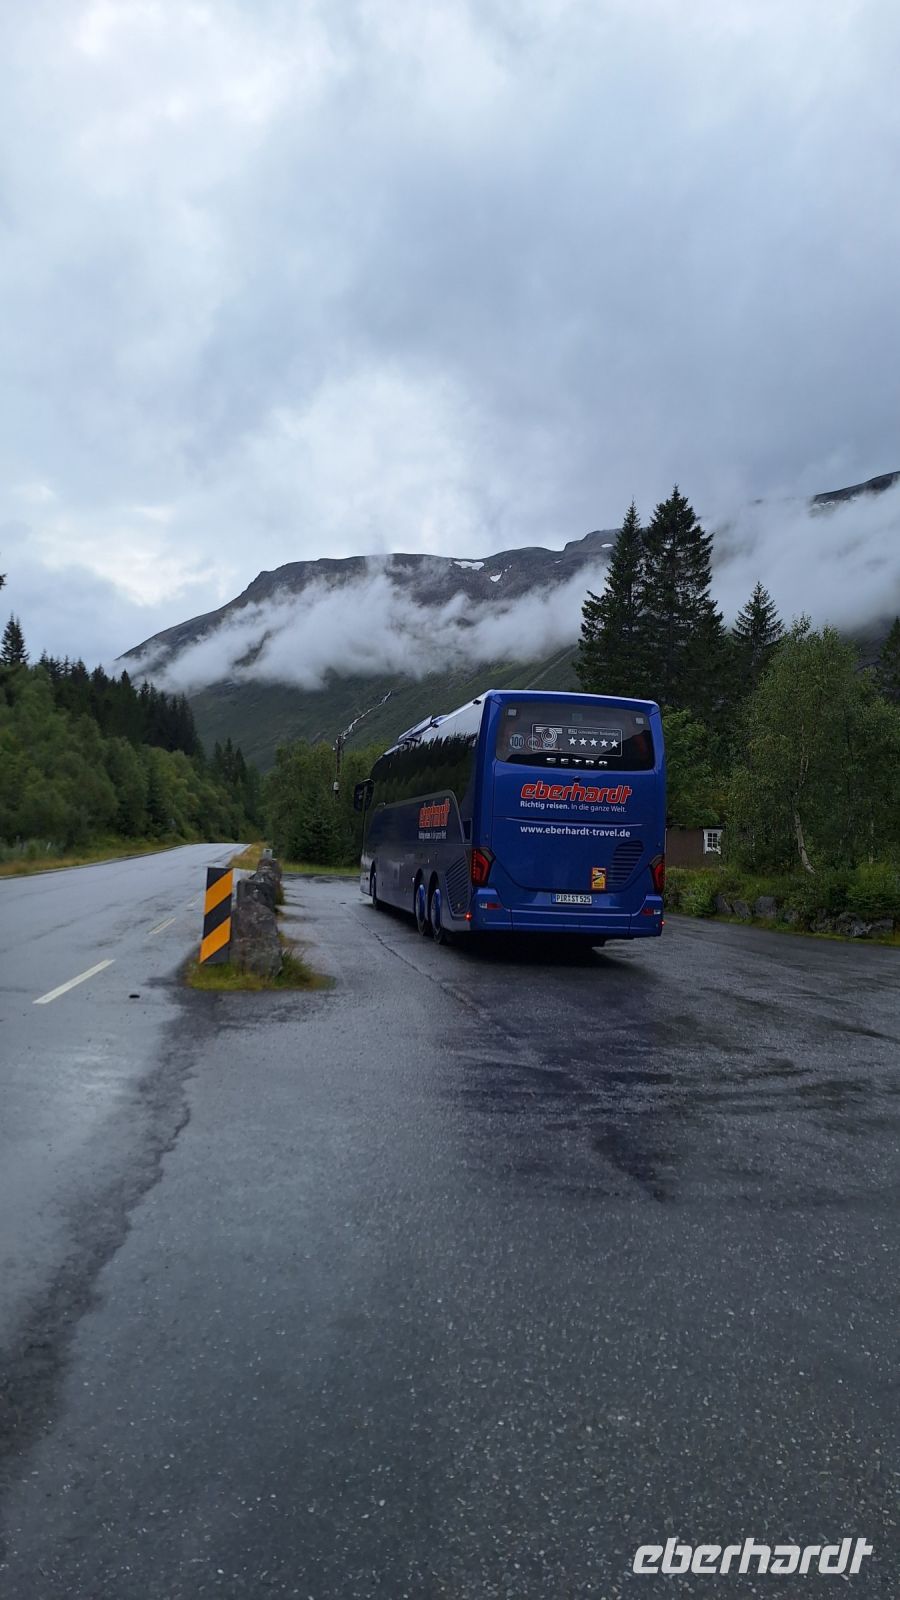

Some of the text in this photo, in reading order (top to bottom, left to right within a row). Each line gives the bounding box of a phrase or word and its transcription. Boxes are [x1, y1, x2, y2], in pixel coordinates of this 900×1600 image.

[511, 736, 524, 747] 100
[520, 780, 633, 805] eberhardt
[520, 800, 545, 810] Richtig
[546, 802, 570, 810] reisen.
[578, 803, 590, 811] die
[590, 805, 610, 813] ganze
[610, 805, 627, 813] Welt.
[520, 826, 631, 838] www.eberhardt-travel.de
